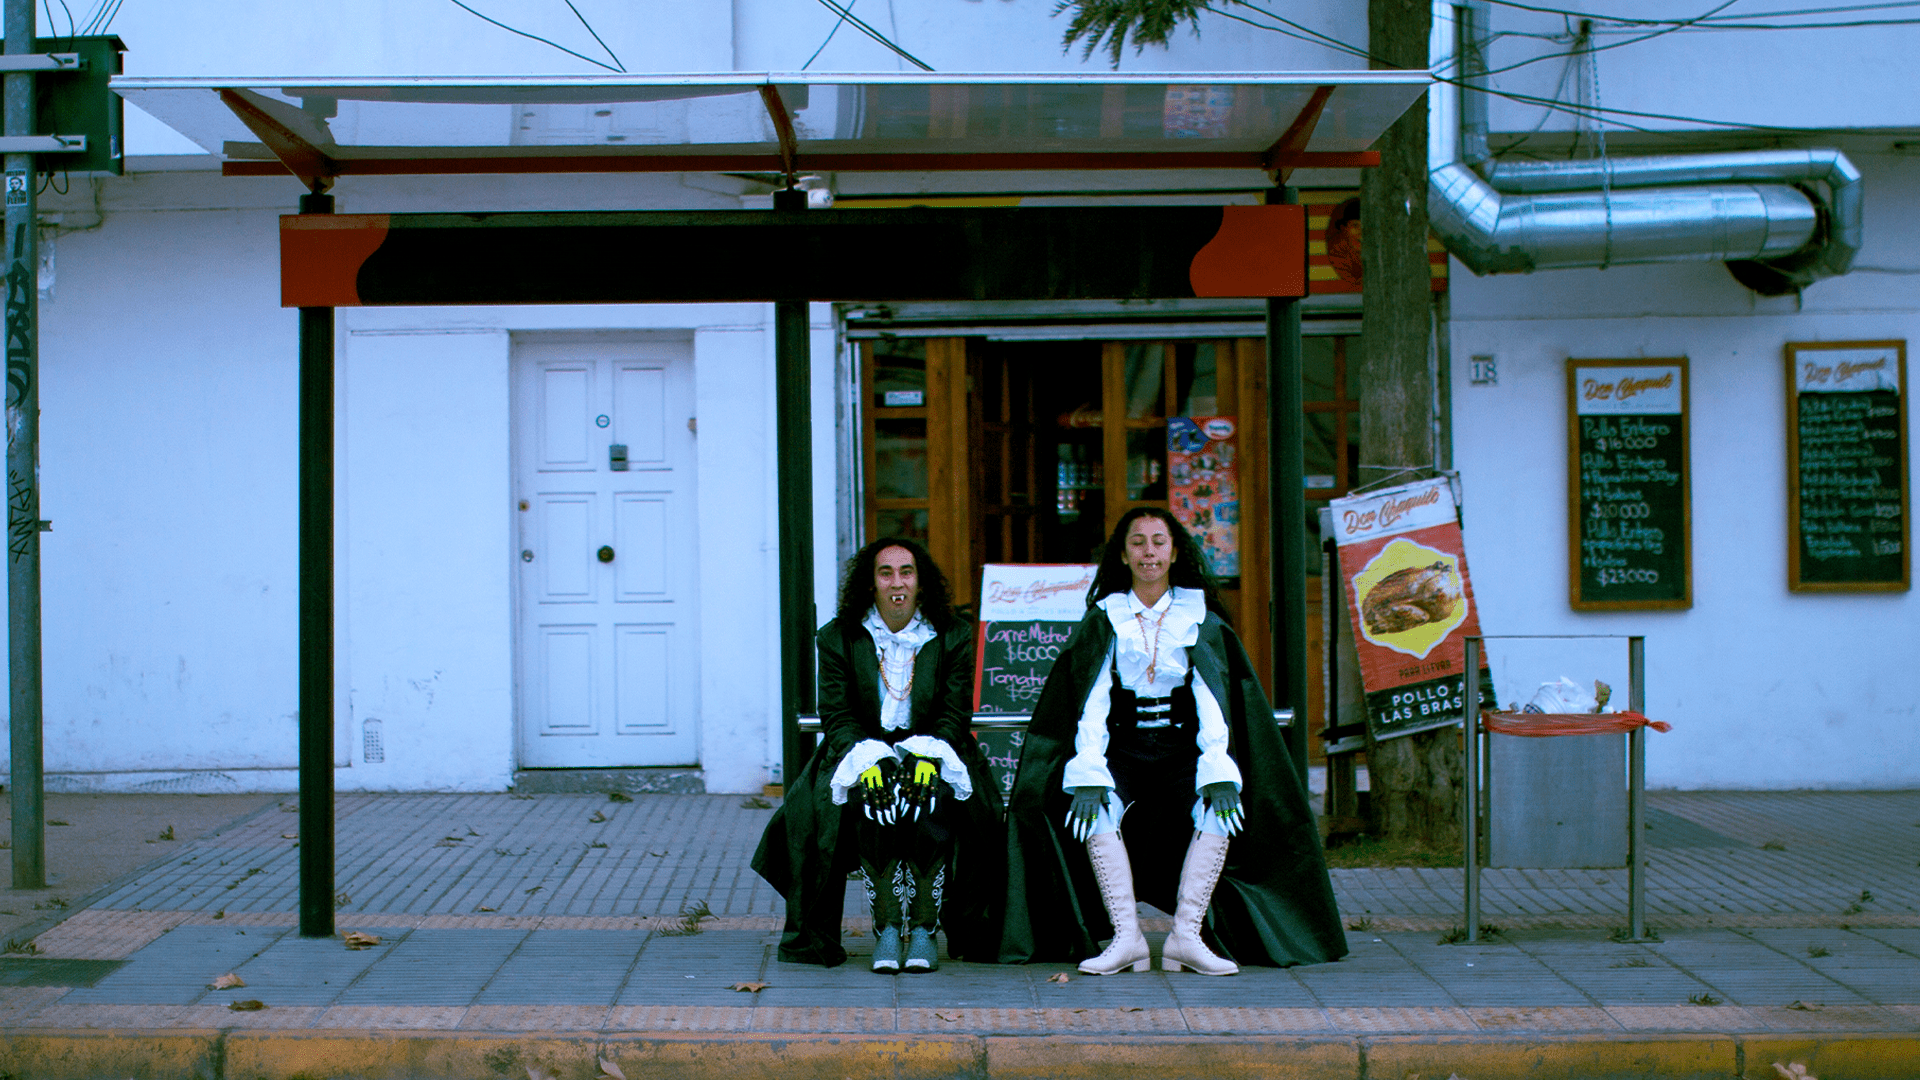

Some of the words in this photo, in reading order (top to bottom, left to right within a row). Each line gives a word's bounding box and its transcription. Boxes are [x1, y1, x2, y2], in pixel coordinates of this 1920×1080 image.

[1474, 362, 1498, 380] 18
[1342, 509, 1377, 535] Don
[985, 621, 1028, 643] Carne
[1029, 622, 1072, 644] Mechad
[1004, 643, 1061, 664] $6000
[1392, 684, 1449, 707] POLLO
[1381, 706, 1413, 724] LAS
[1420, 691, 1485, 716] BRASS
